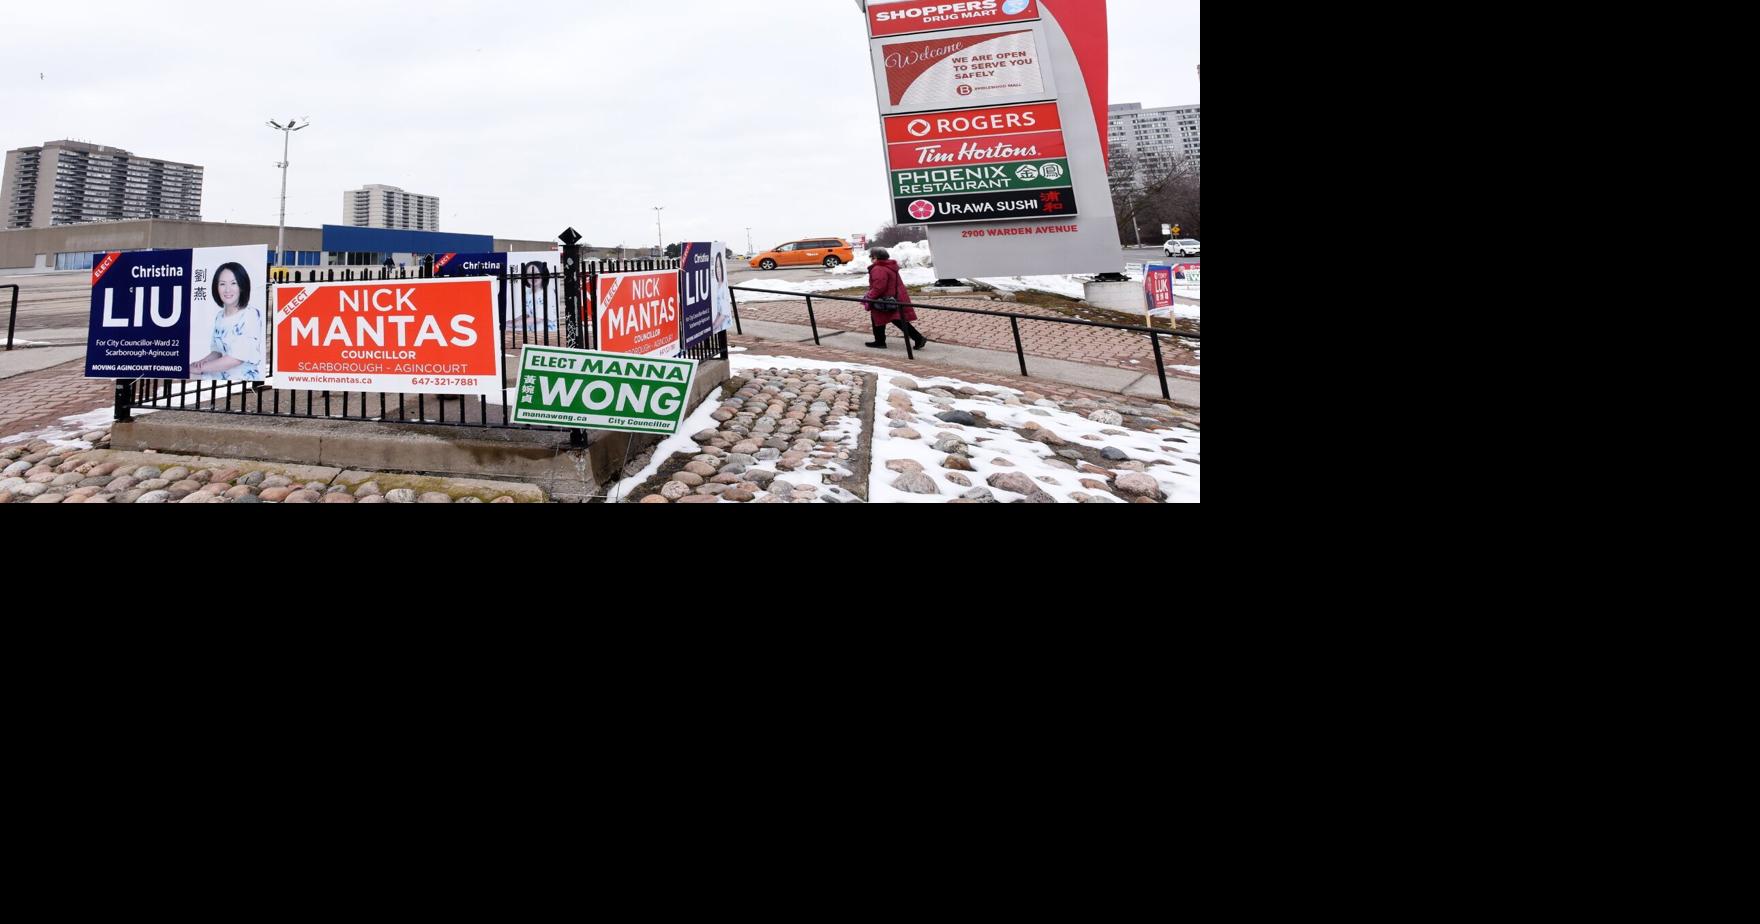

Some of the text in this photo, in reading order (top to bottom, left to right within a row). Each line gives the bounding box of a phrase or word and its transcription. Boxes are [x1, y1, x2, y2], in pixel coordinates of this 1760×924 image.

[876, 0, 997, 22] SHOPPERS
[923, 9, 997, 23] DRUG MART
[884, 41, 964, 69] Welcome
[971, 54, 993, 62] ARE
[996, 51, 1027, 59] OPEN
[971, 61, 1006, 70] SERVE
[1009, 58, 1033, 66] YOU
[954, 70, 995, 79] SAFELY
[937, 111, 1036, 133] ROGERS
[915, 142, 1037, 165] Tim Hortons
[898, 165, 1007, 184] PHOENIX
[900, 178, 1012, 194] RESTAURANT
[938, 200, 1038, 215] URAWA SUSHI
[961, 224, 1078, 238] 2900 WARDEN AVENUE
[94, 256, 113, 278] ELECT
[131, 264, 183, 279] Christina
[632, 278, 660, 300] NICK
[686, 268, 709, 306] LIU
[102, 286, 182, 327] LIU
[283, 290, 309, 315] ELECT
[339, 288, 418, 312] NICK
[608, 297, 675, 339] MANTAS
[290, 314, 478, 347] MANTAS
[96, 339, 179, 348] For City Councillor-Ward 22
[105, 348, 179, 358] Scarborough-Agincourt
[341, 350, 416, 360] COUNCILLOR
[298, 361, 383, 373] SCARBOROUGH
[394, 363, 468, 374] AGINCOURT
[531, 355, 684, 381] ELECT MANNA
[288, 375, 478, 387] www.nickmantas.ca 647-321-7881
[539, 375, 681, 416] WONG
[522, 411, 671, 429] mannawong.ca City Councillor
